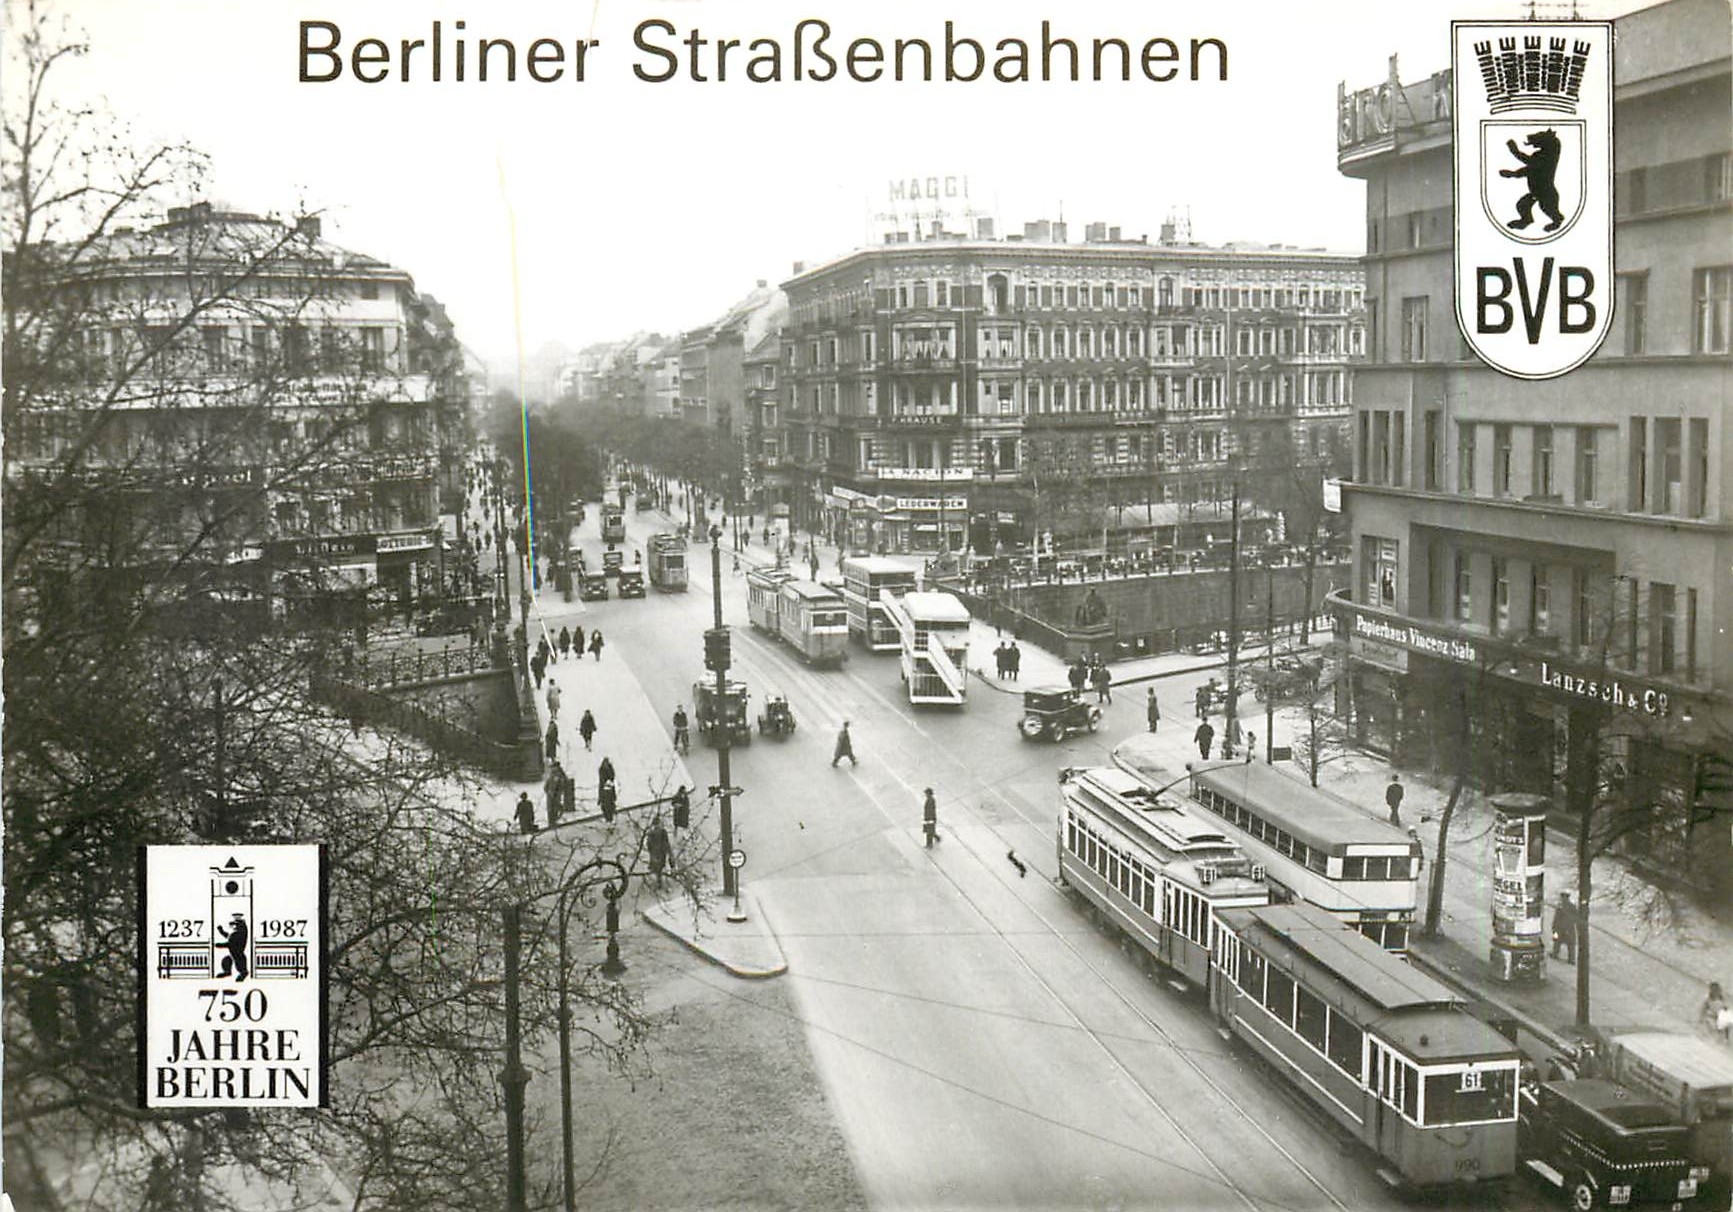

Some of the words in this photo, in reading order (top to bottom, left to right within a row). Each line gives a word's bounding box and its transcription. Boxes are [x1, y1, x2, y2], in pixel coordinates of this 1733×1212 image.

[888, 175, 968, 201] MAGGI
[1356, 614, 1407, 644] Papierhaus
[1408, 626, 1449, 656] Vincenz
[1627, 692, 1638, 709] &
[1464, 1073, 1478, 1088] 61
